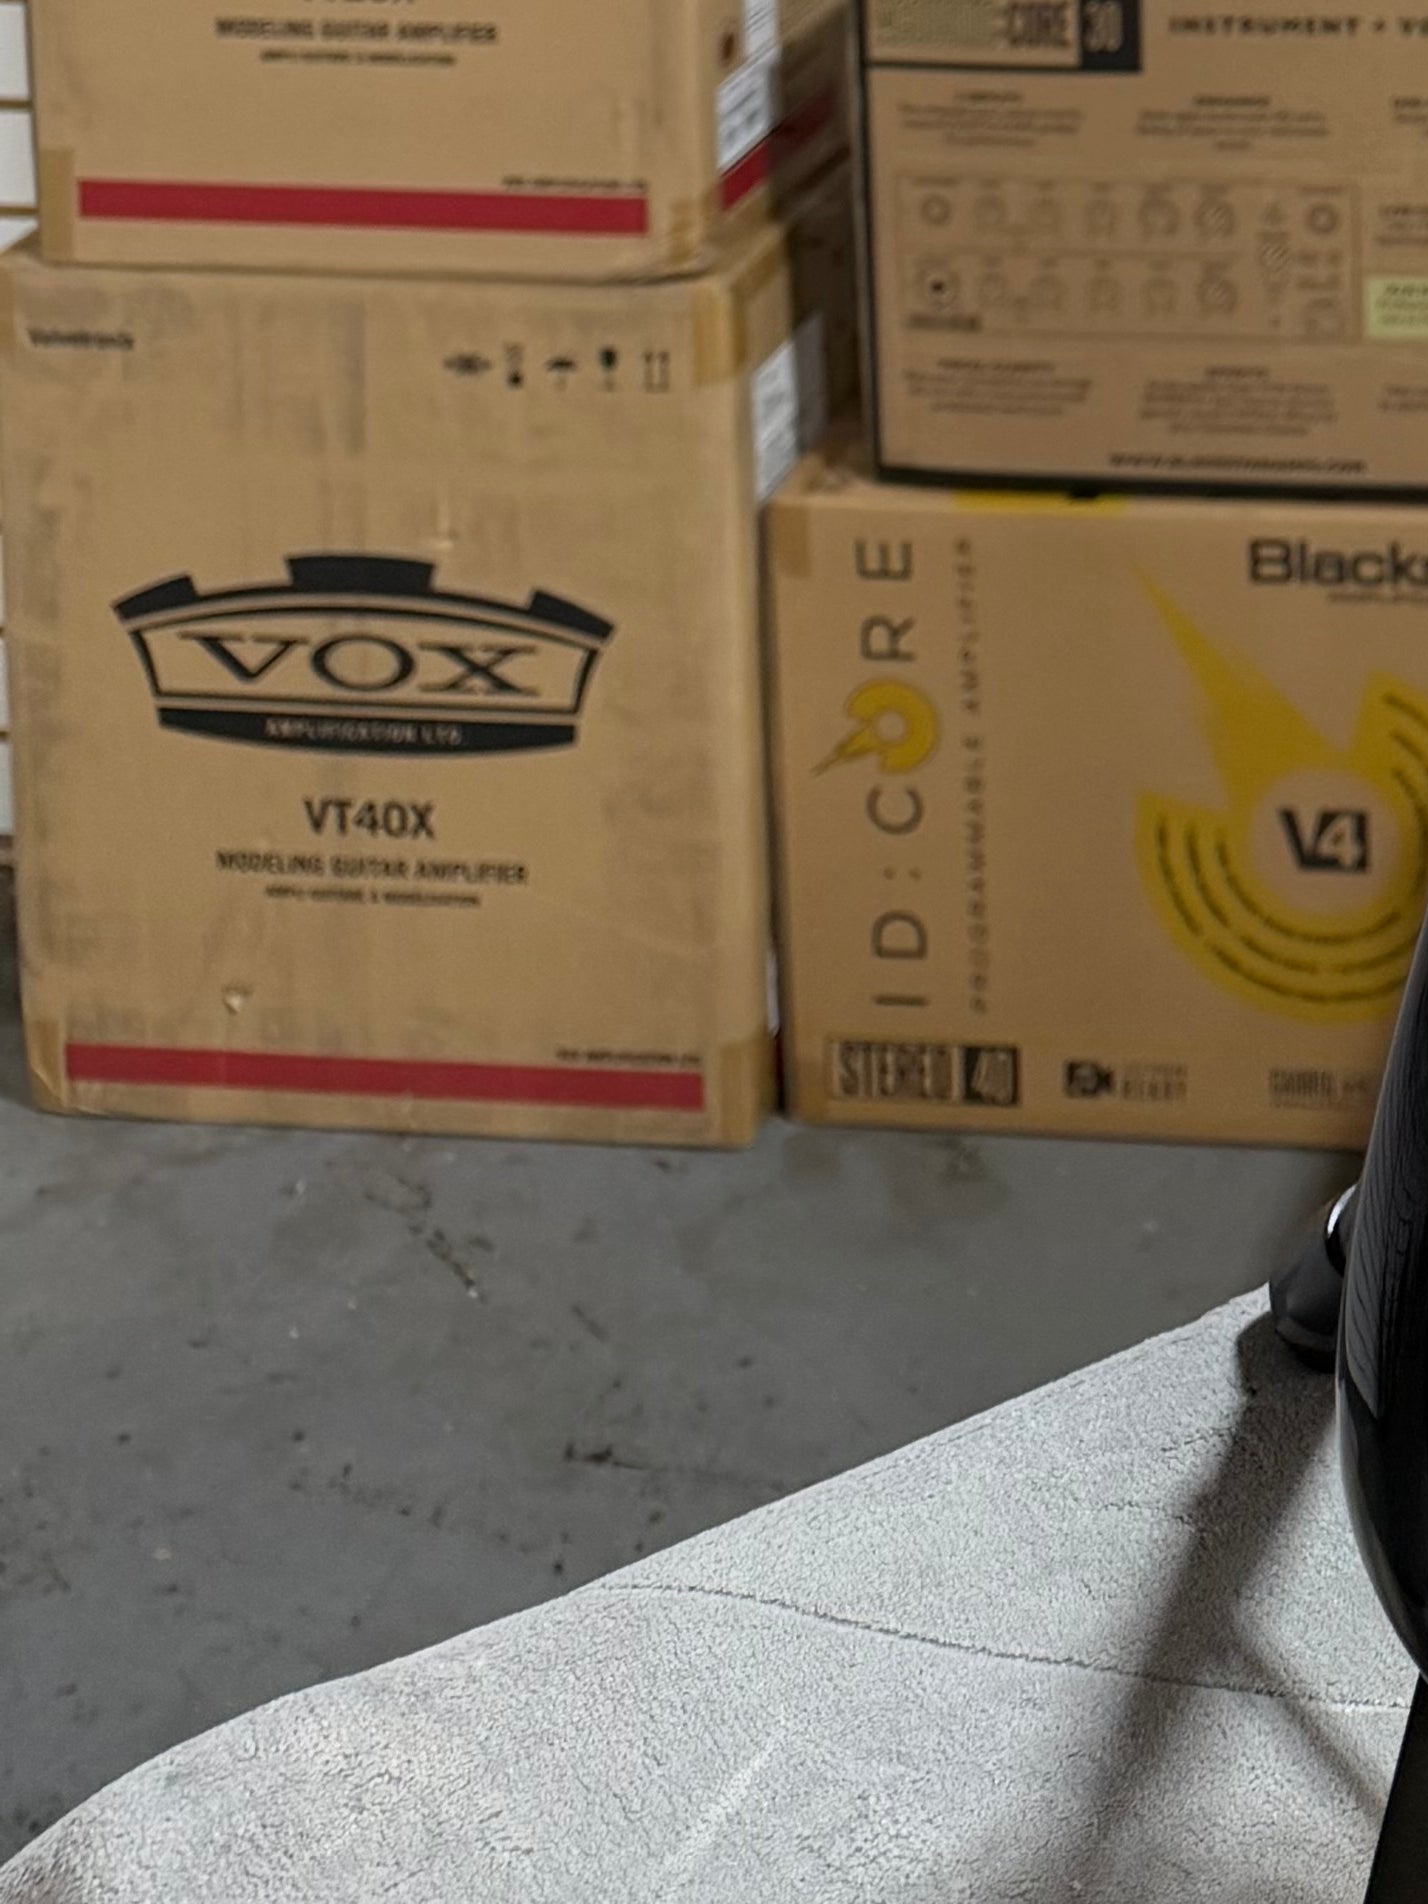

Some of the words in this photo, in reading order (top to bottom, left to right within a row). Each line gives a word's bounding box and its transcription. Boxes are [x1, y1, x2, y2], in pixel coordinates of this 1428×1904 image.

[215, 15, 315, 41] MODELING
[320, 17, 391, 43] GUITAR
[396, 20, 499, 46] AMPLIFIER
[1169, 15, 1360, 38] INSTRUMENT
[178, 632, 541, 698] VOX
[302, 797, 437, 843] VT40X
[216, 850, 325, 878] MODELING
[330, 855, 408, 881] GUITAR
[413, 858, 528, 886] AMPLIFIER
